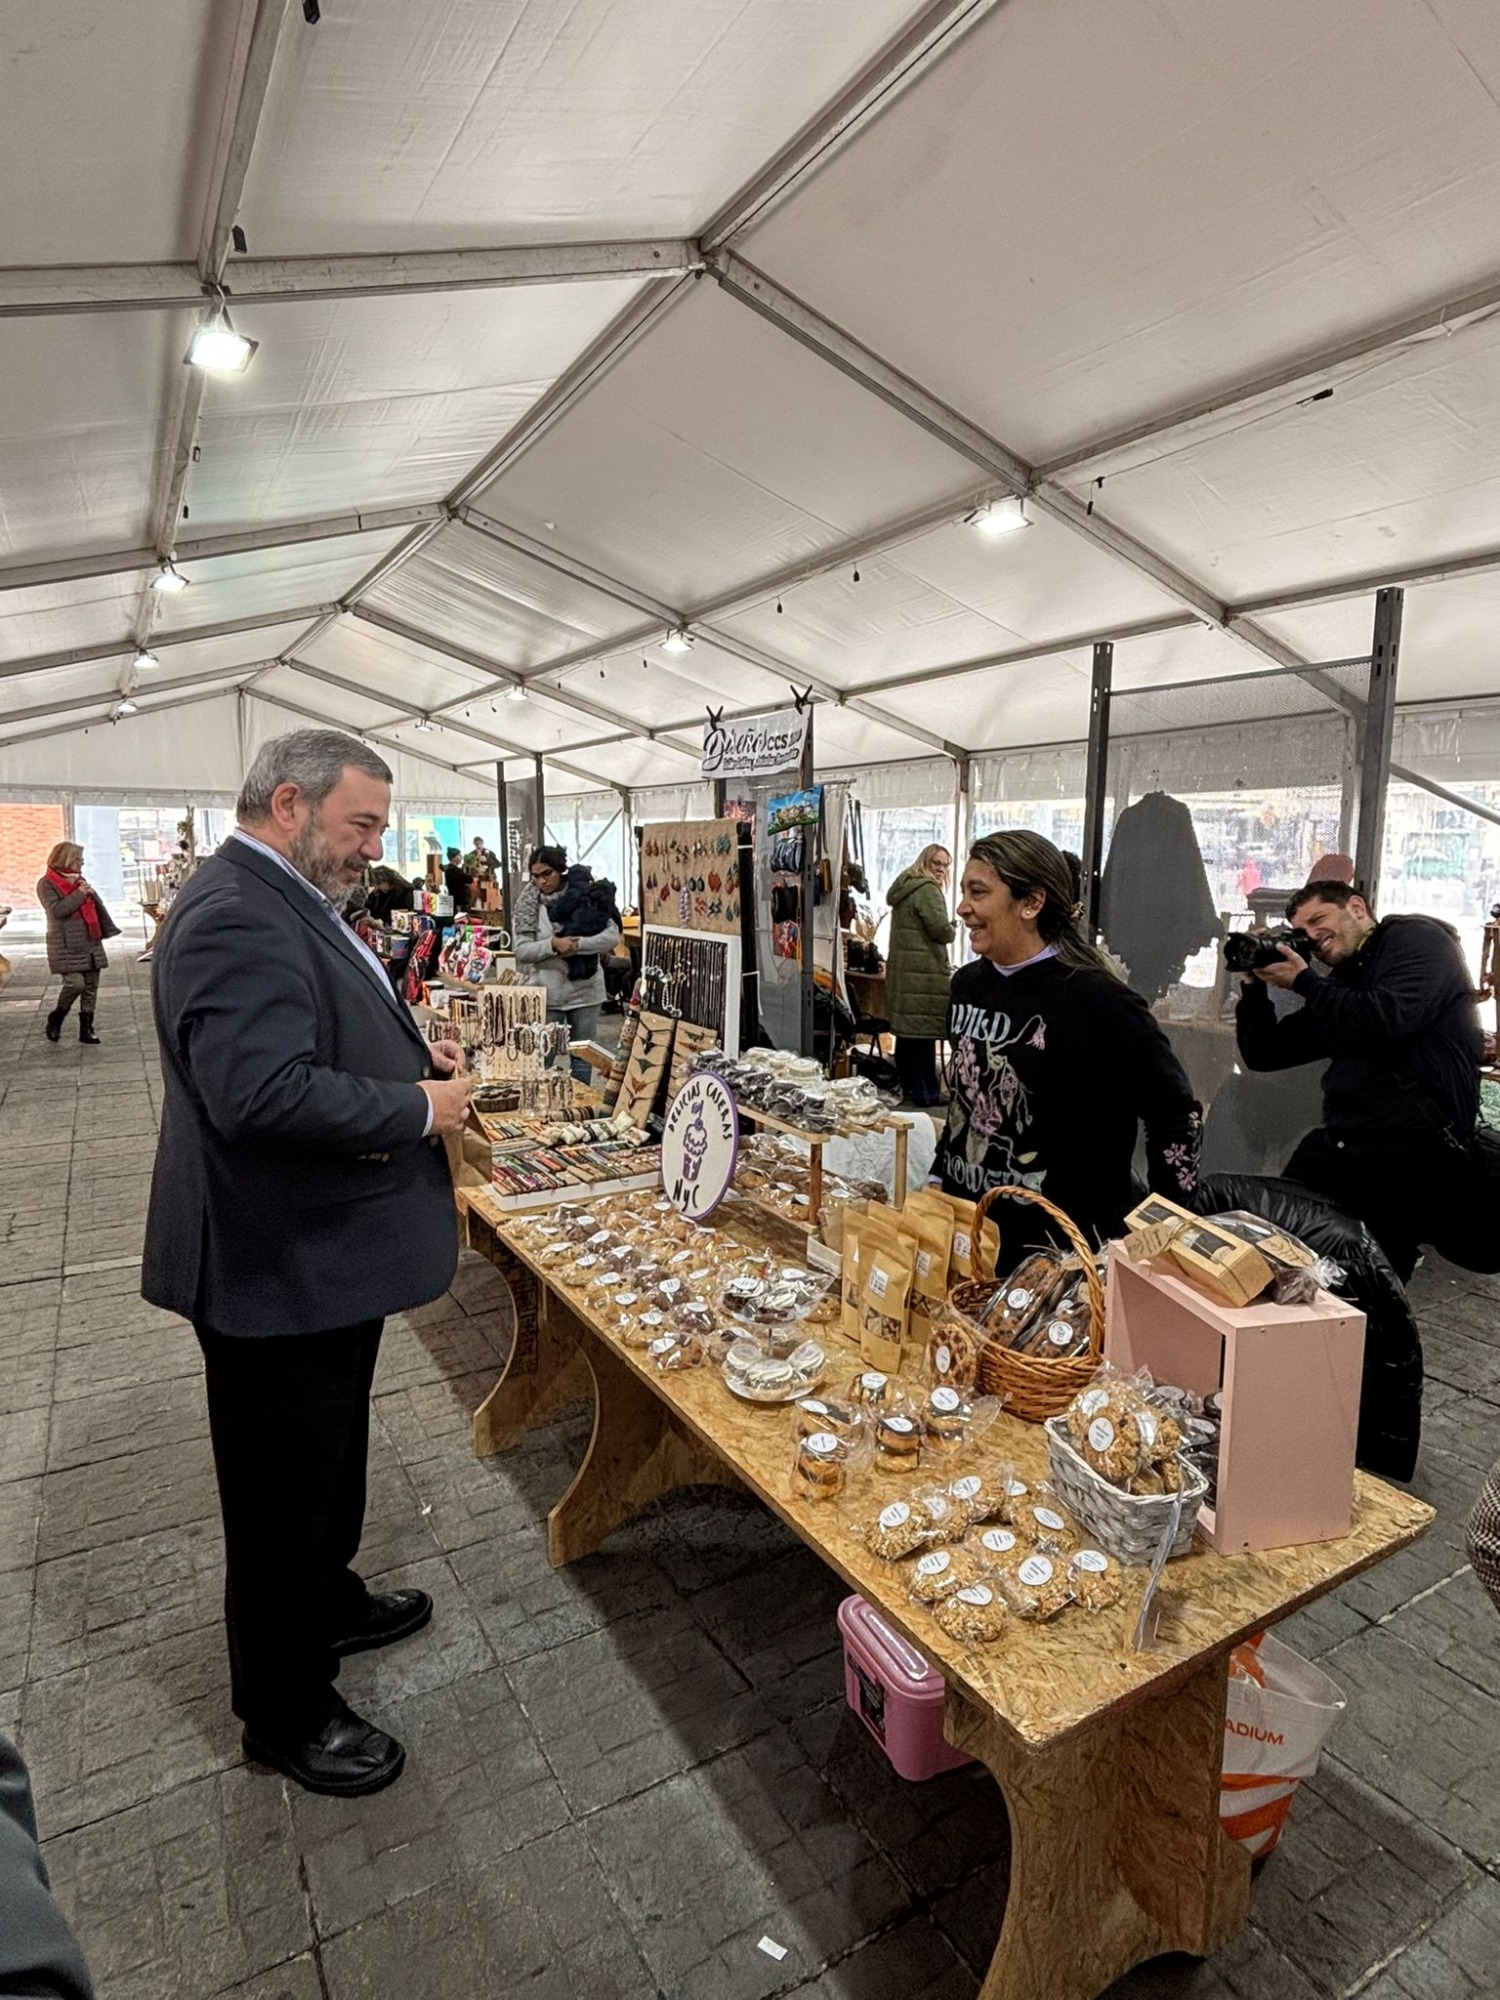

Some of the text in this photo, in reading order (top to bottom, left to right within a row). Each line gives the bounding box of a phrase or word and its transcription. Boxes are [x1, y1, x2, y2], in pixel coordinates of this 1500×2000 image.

[951, 1004, 1012, 1042] WILD
[668, 1081, 733, 1141] DELICIAS CASERAS
